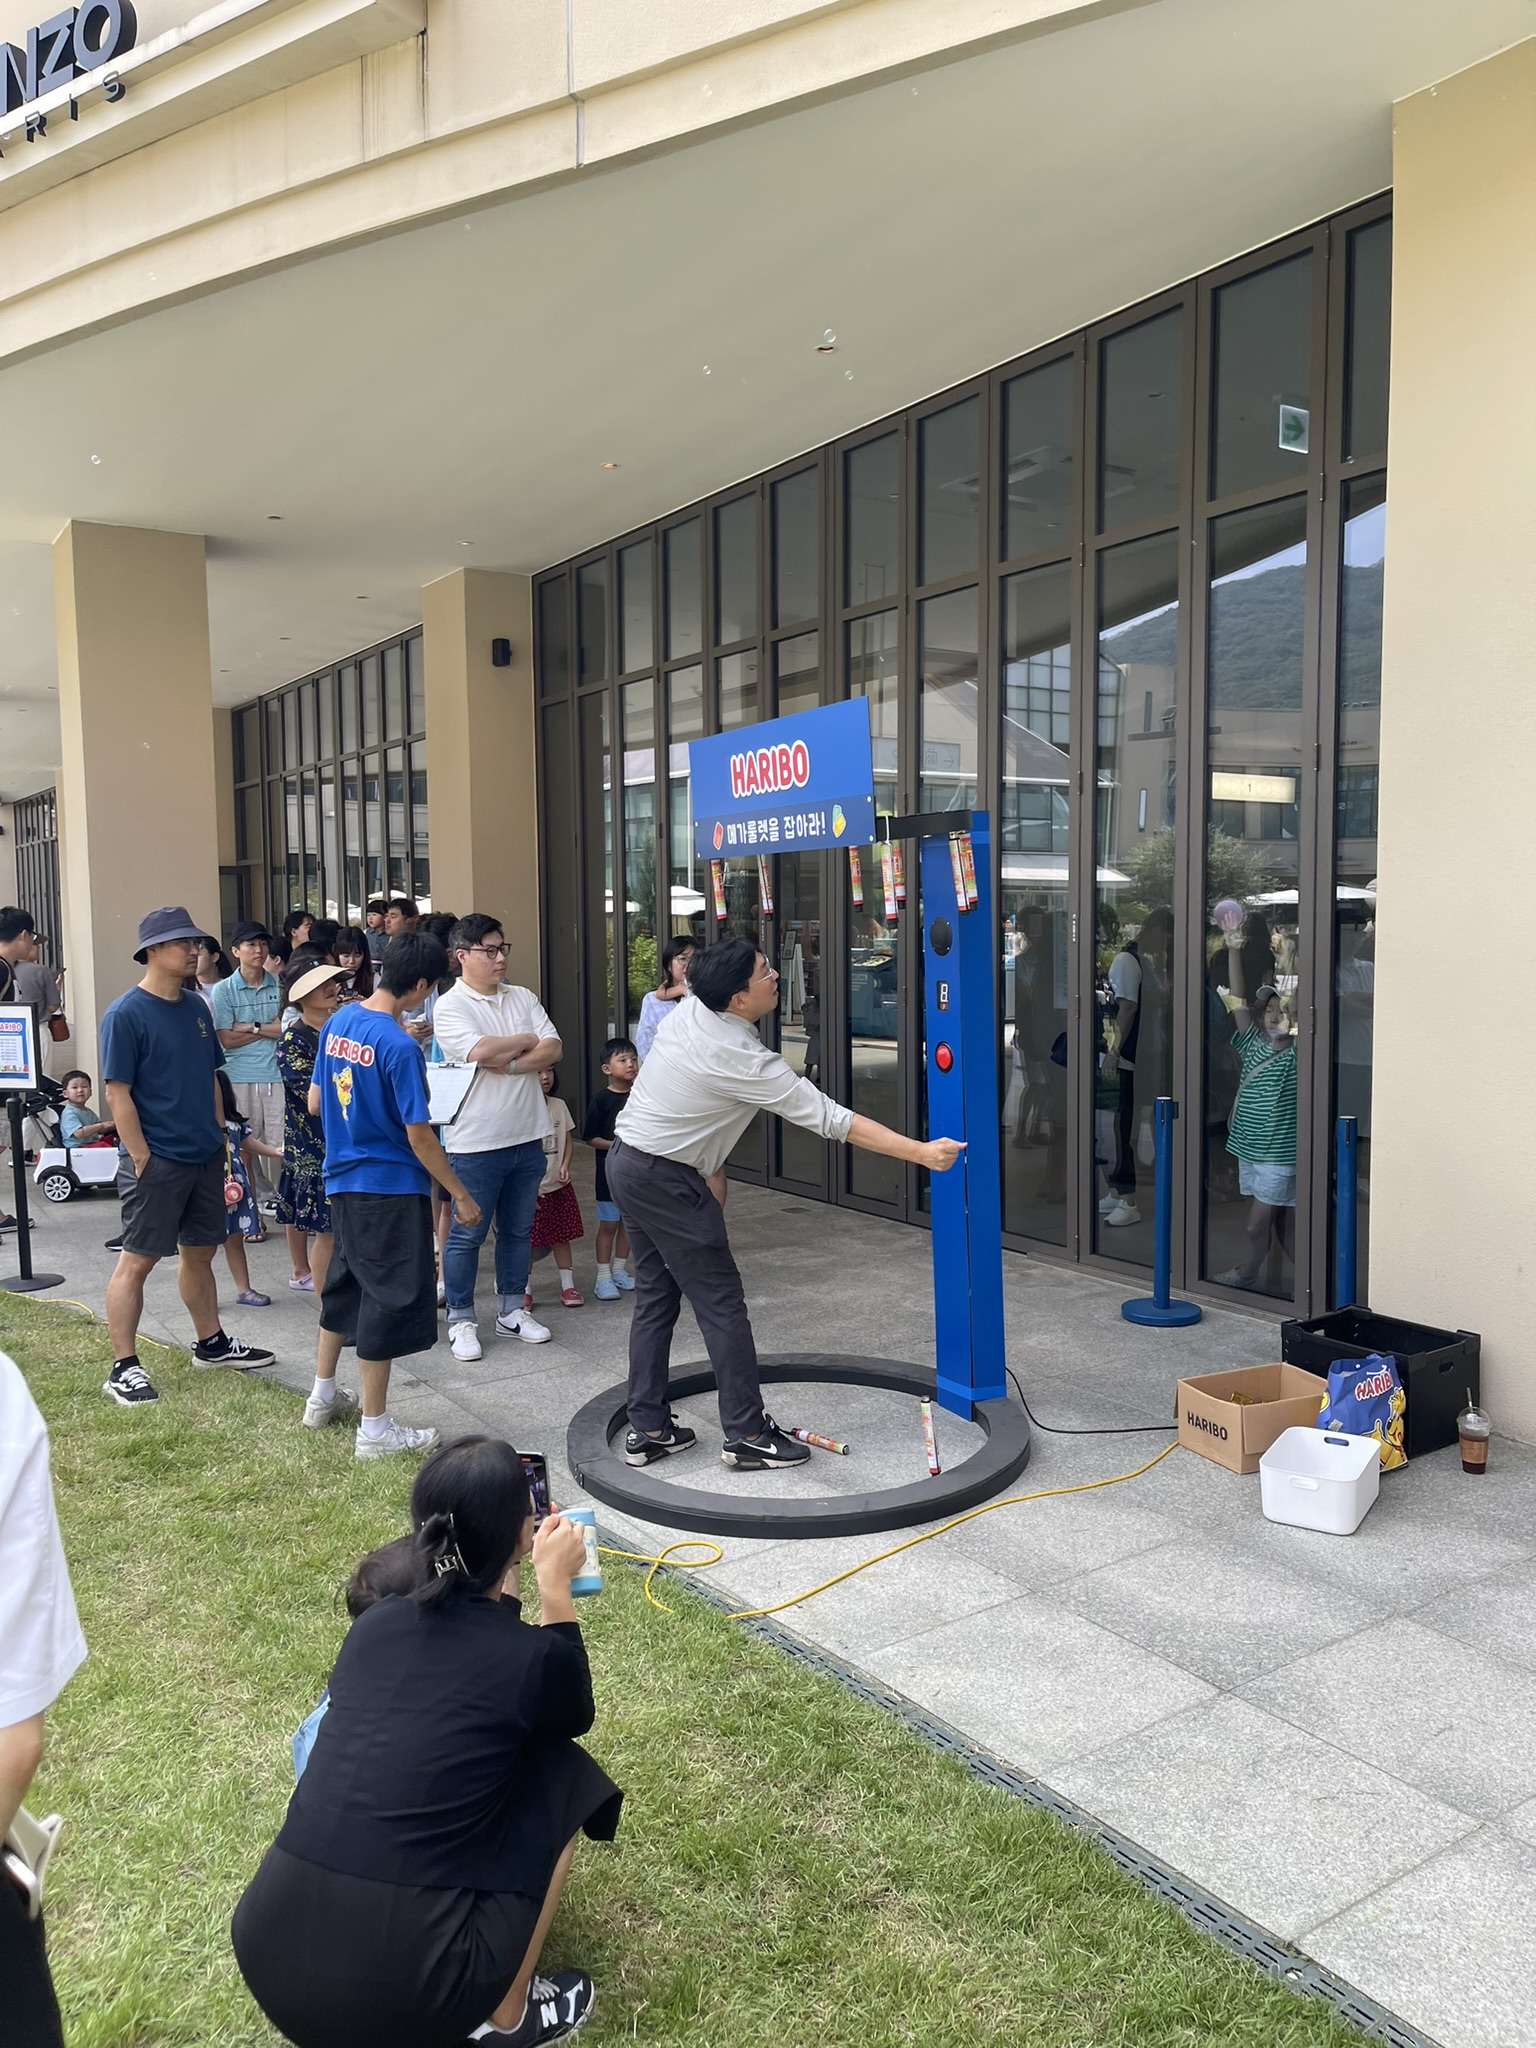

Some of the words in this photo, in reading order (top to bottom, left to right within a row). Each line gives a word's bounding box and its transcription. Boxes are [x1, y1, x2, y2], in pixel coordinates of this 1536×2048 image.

[0, 71, 126, 158] RIS
[730, 740, 810, 798] HARIBO
[726, 817, 780, 845] 메가룰렛을
[783, 811, 826, 840] 잡아라!
[1355, 1370, 1394, 1401] HARIB
[1187, 1410, 1228, 1441] HARIBO
